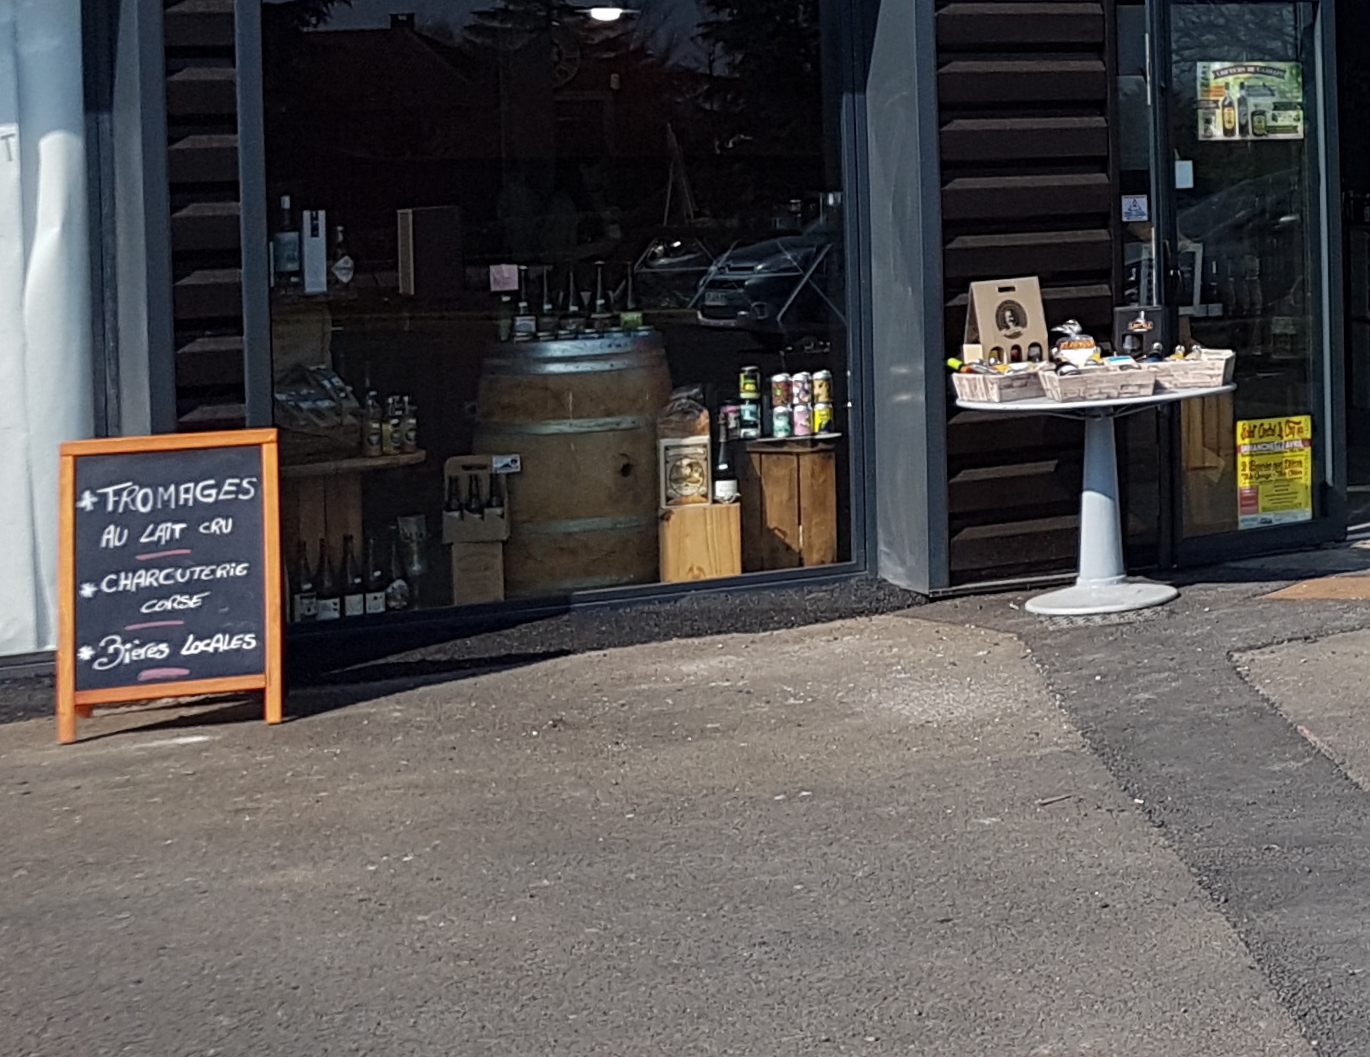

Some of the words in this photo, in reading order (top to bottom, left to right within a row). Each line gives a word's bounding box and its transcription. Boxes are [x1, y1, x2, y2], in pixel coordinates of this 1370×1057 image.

[96, 477, 258, 513] FROMAGES
[101, 524, 128, 548] AU
[198, 517, 233, 535] CRU
[140, 591, 212, 614] CORSE
